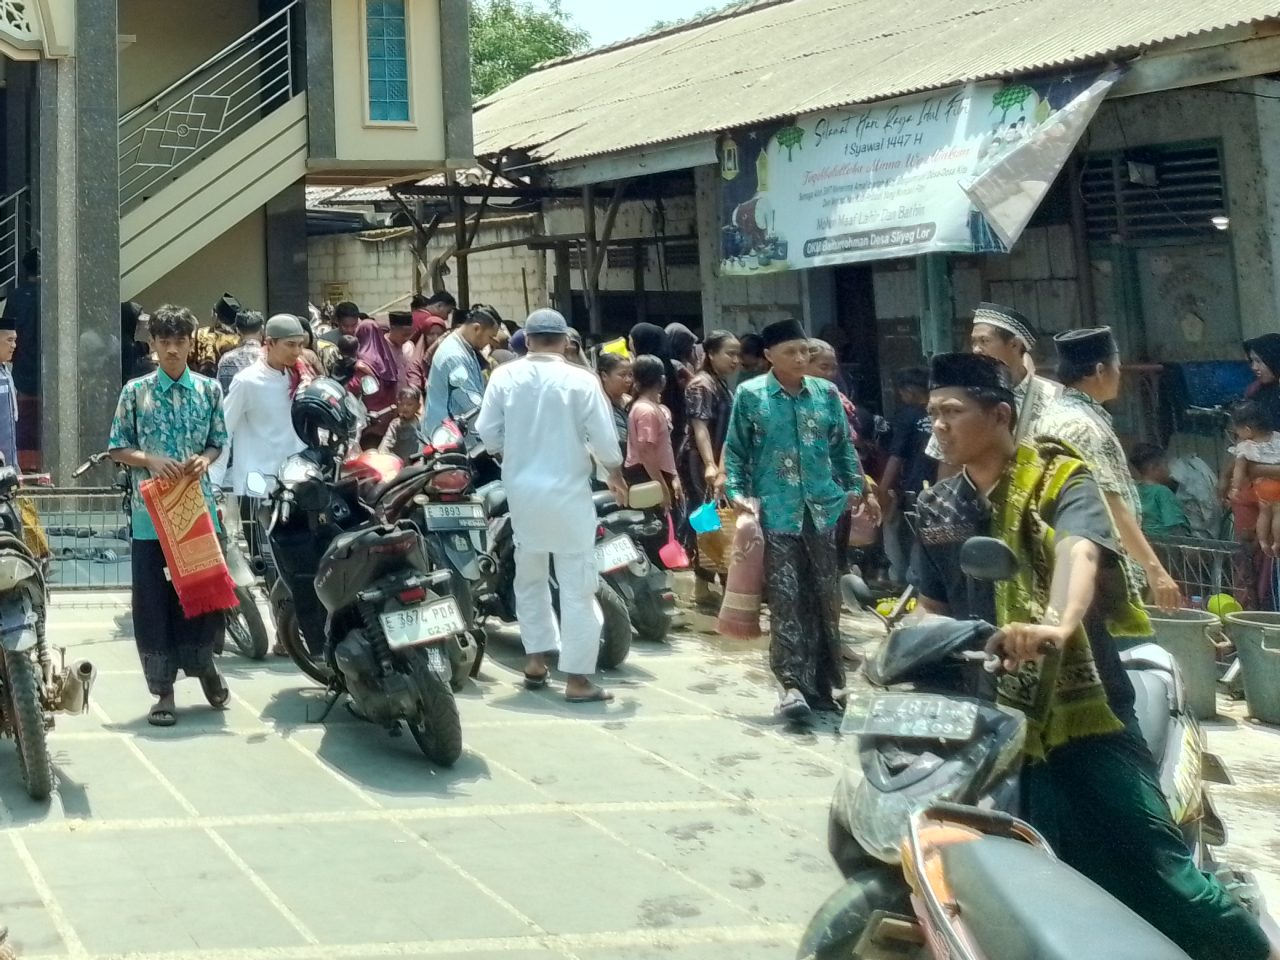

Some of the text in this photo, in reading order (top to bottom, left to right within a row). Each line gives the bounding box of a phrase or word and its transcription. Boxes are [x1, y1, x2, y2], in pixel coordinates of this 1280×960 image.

[883, 104, 913, 134] Raya
[916, 97, 942, 127] Idul
[849, 137, 884, 158] Syawal
[886, 133, 912, 150] 1447
[913, 132, 924, 145] H
[870, 232, 890, 246] Desa
[891, 229, 915, 247] Sliyeg
[916, 227, 930, 241] Lor
